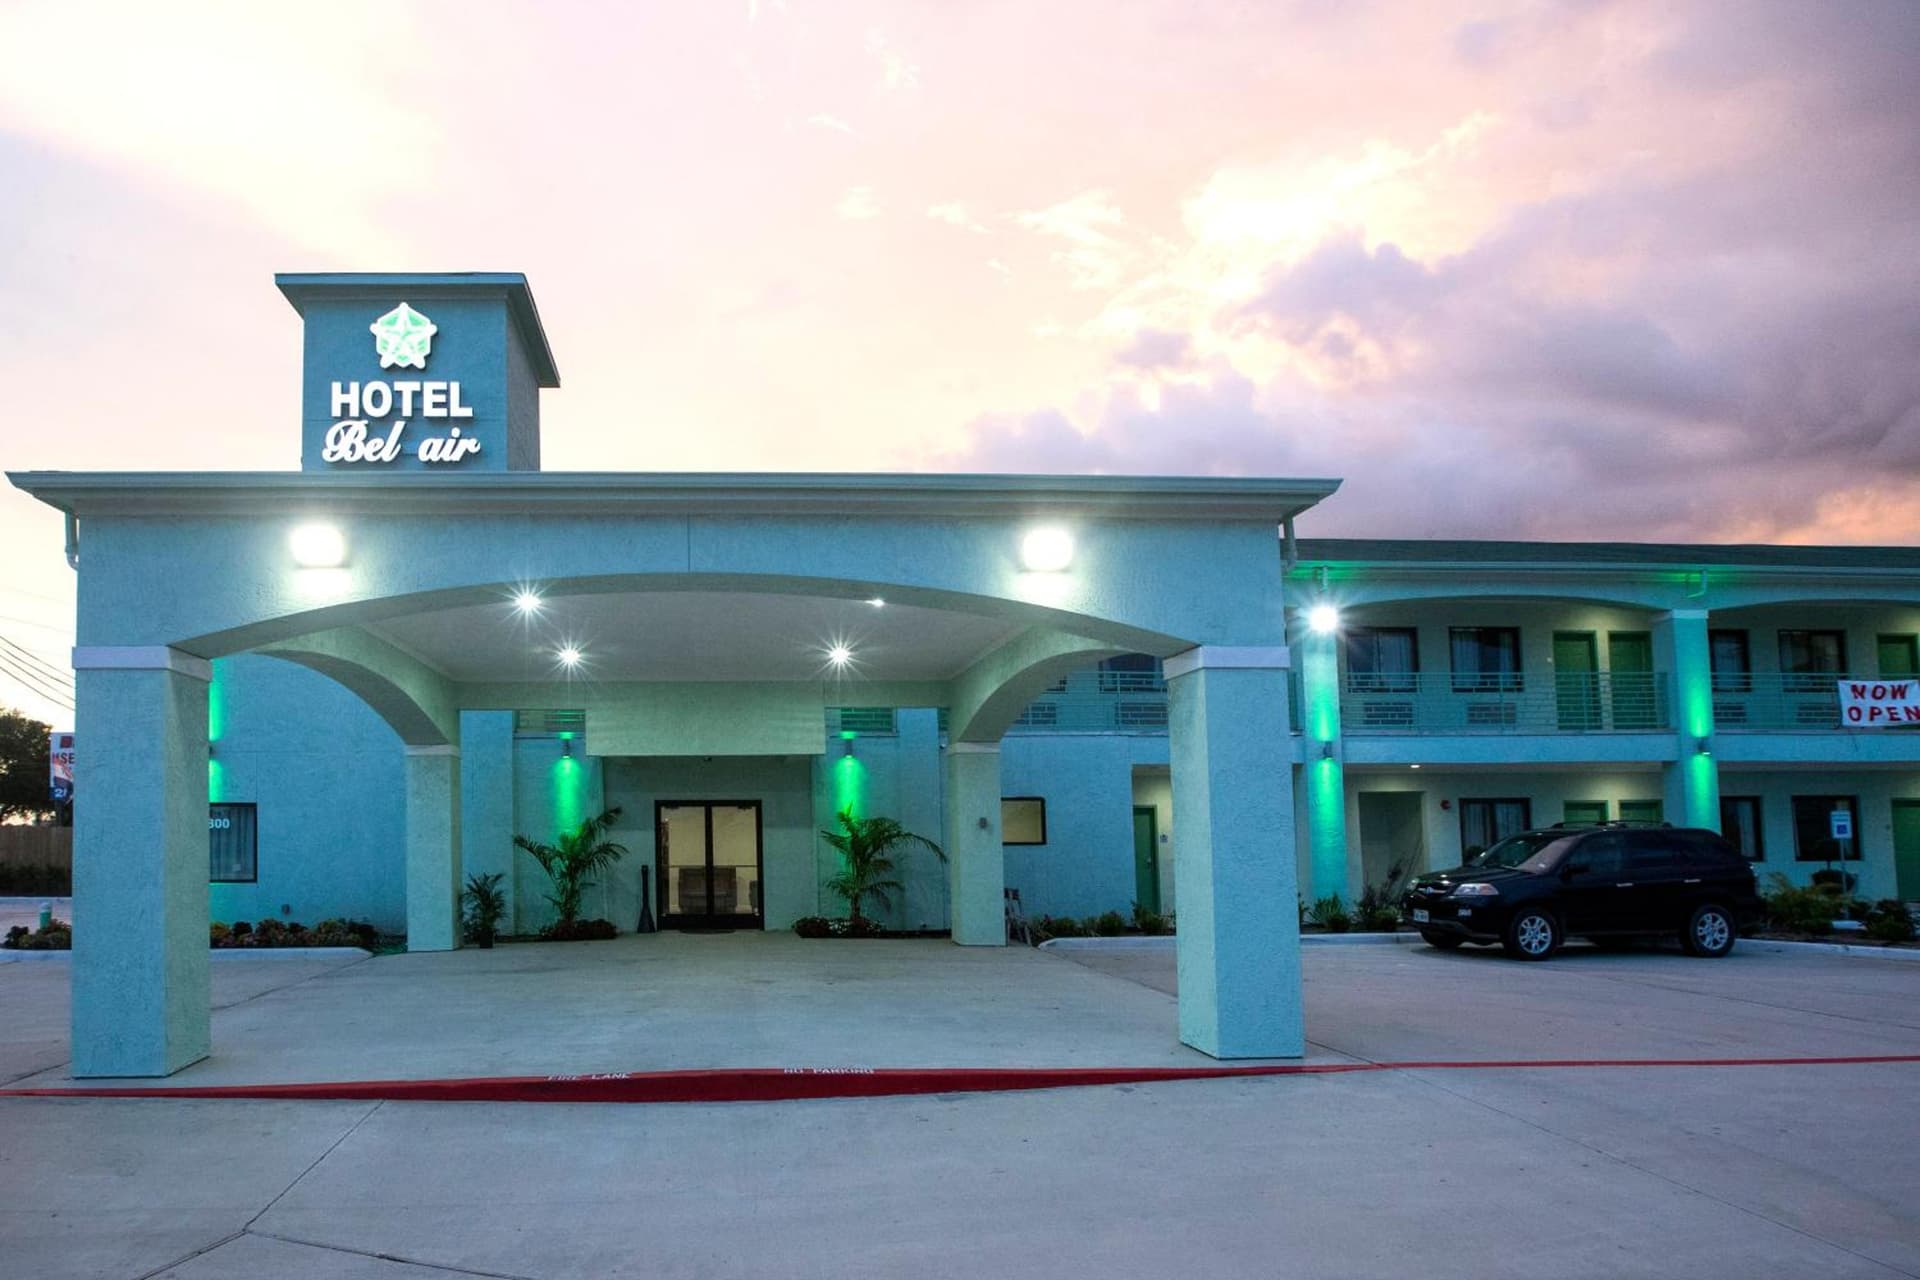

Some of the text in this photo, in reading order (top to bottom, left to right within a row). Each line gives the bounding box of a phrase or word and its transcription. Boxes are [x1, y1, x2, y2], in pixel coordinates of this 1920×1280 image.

[331, 381, 473, 417] HOTEL
[322, 420, 480, 462] Bel air
[1850, 684, 1907, 700] NOW
[1848, 706, 1920, 722] OPEN
[813, 1067, 875, 1075] PARKING
